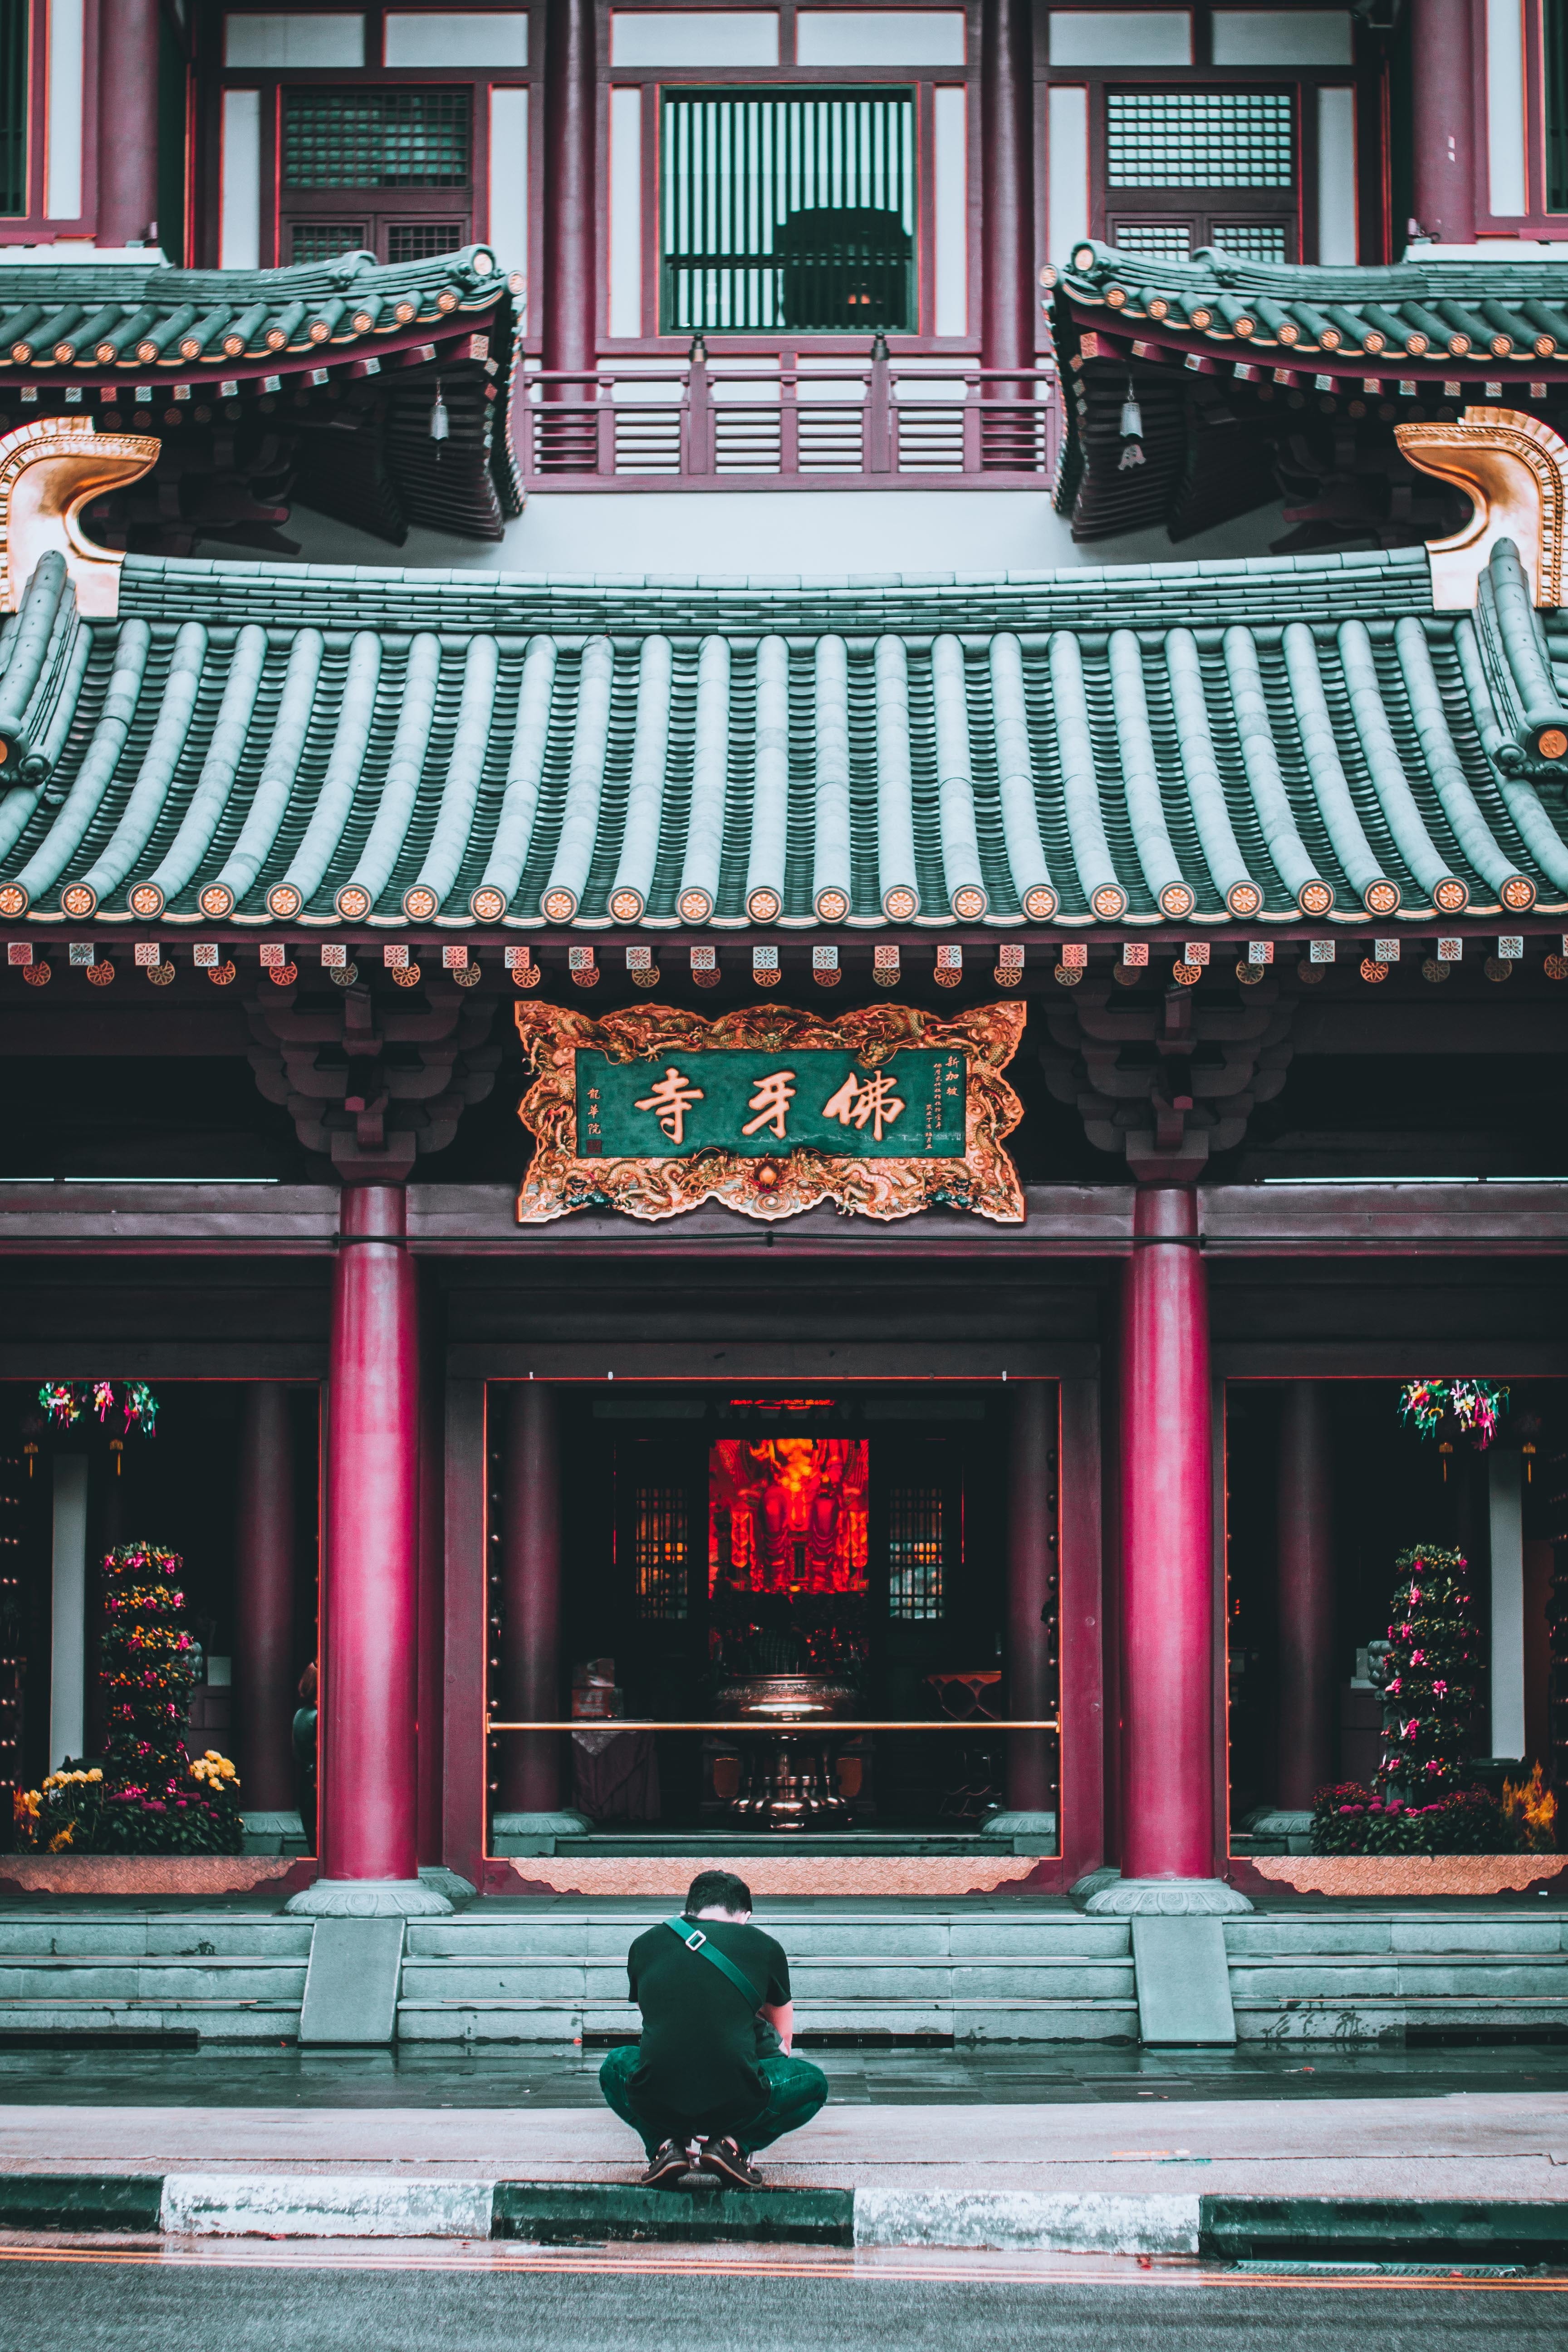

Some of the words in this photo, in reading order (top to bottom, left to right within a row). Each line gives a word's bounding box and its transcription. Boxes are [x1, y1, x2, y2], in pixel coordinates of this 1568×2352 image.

[945, 1055, 960, 1096] 新加坡
[587, 1088, 601, 1134] 龍華院
